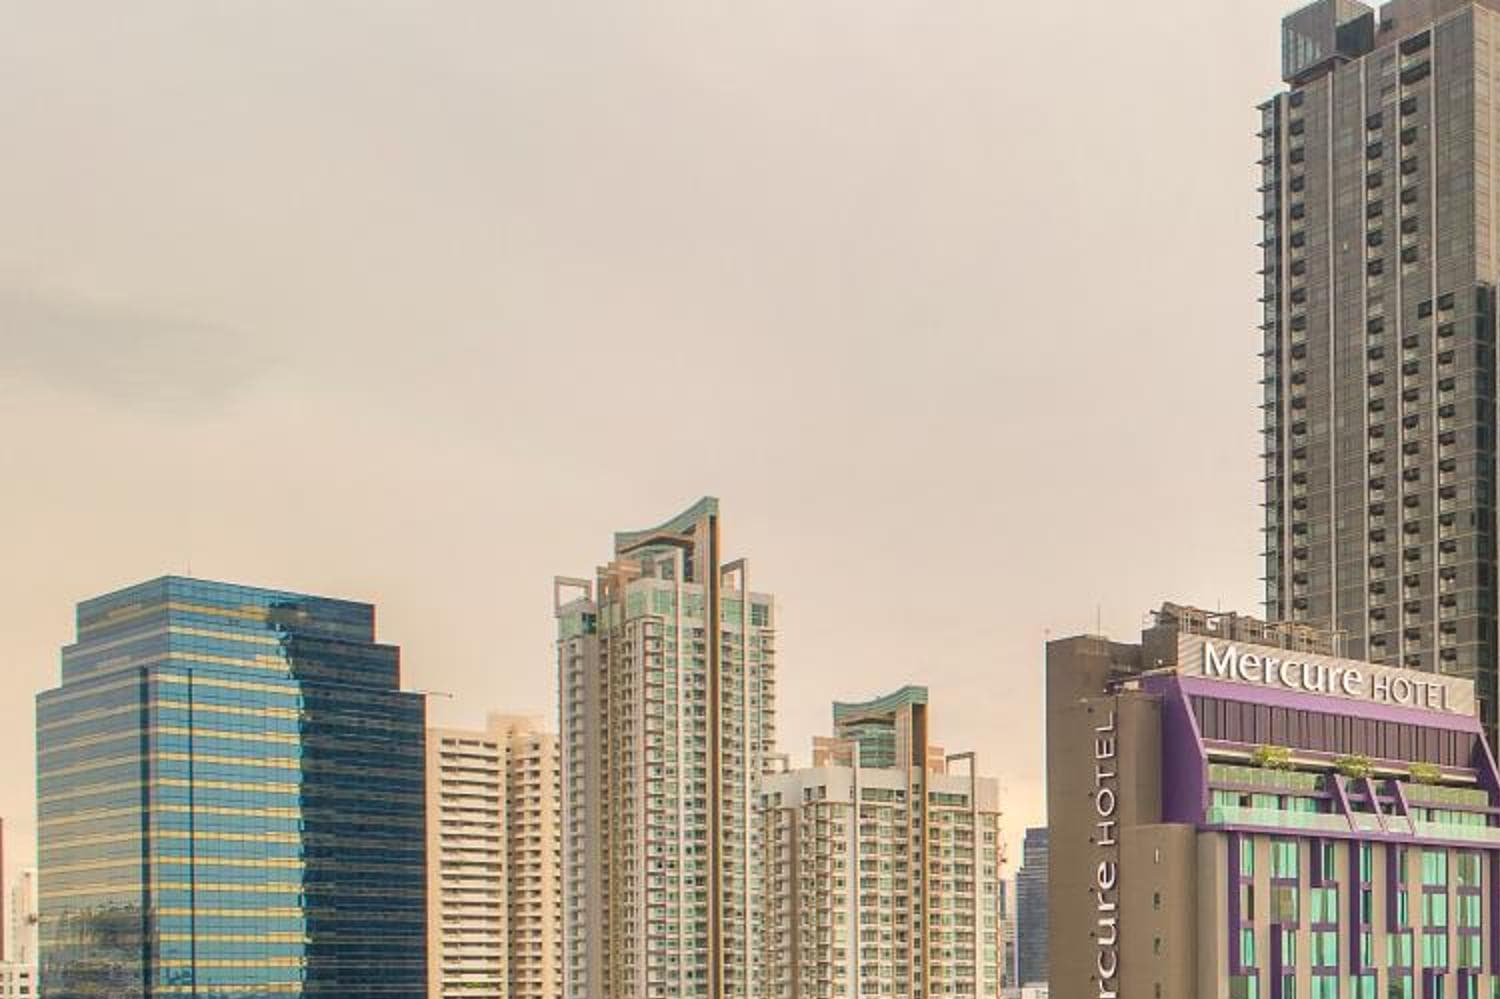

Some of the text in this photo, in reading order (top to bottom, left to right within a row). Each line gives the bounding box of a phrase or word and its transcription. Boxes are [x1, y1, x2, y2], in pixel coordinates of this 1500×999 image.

[1204, 642, 1456, 710] Mercure HOTEL
[1096, 711, 1116, 846] HOTEL
